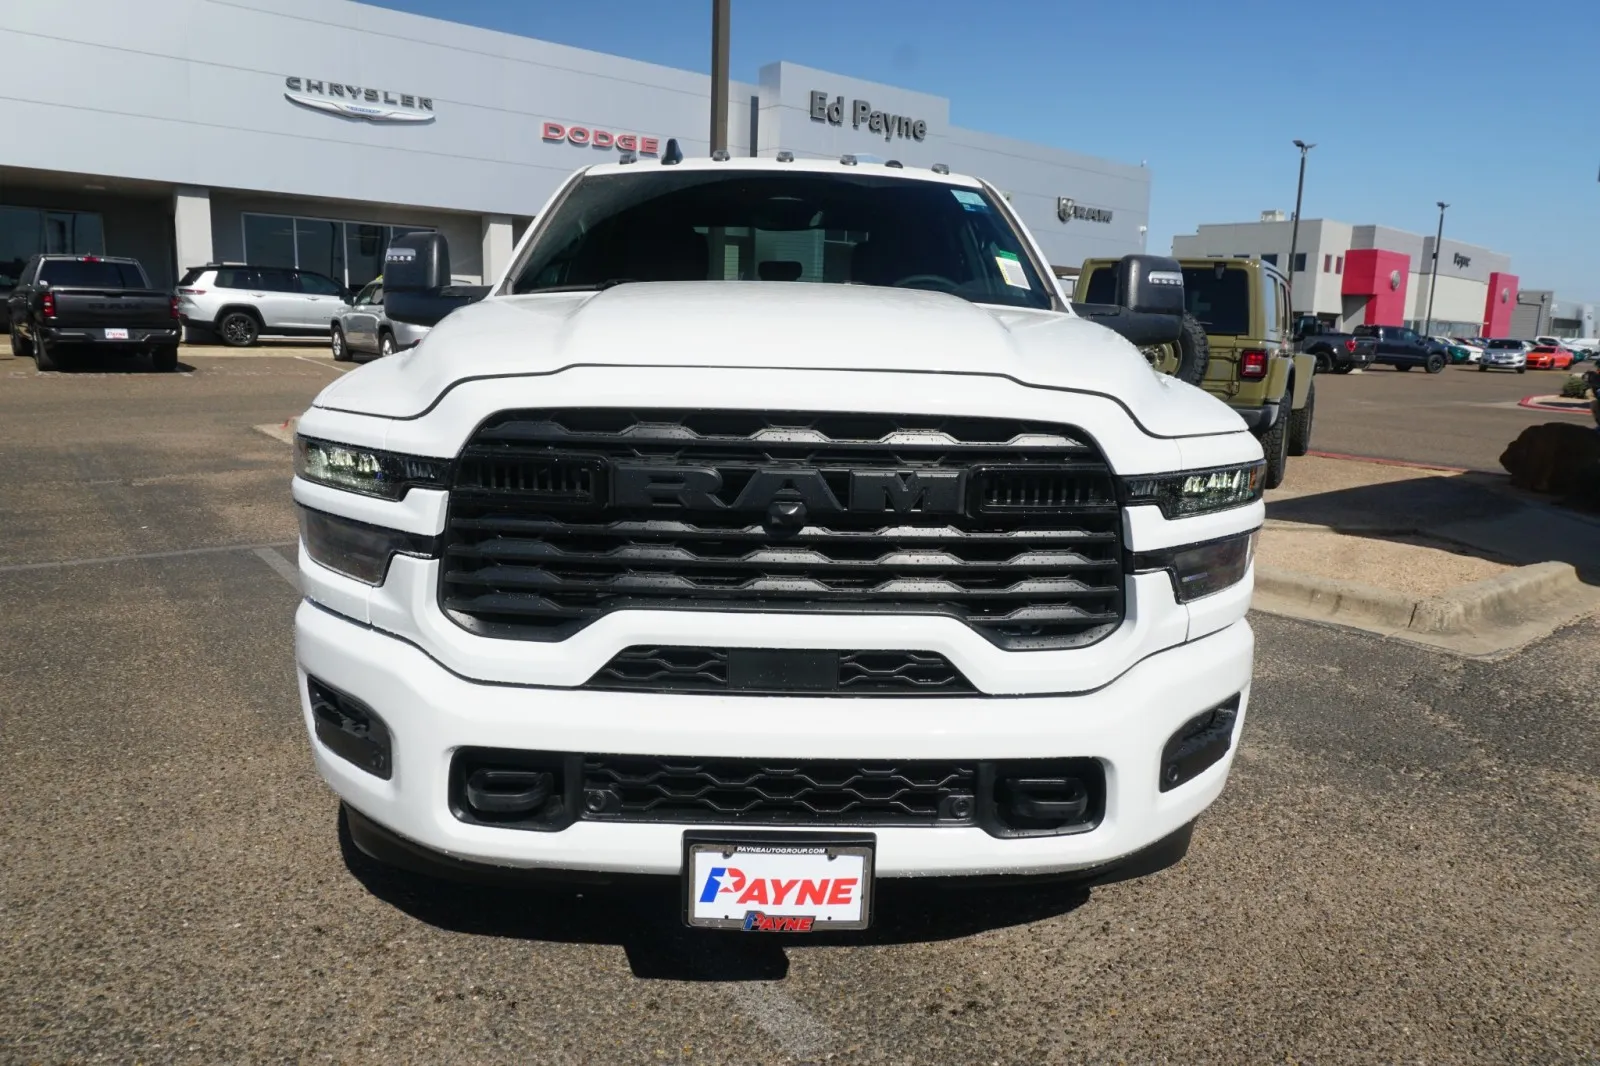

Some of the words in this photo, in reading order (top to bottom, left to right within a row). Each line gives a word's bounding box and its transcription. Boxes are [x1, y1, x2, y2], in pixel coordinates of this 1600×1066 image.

[286, 76, 433, 111] CHRYSLER
[810, 90, 845, 127] Ed
[852, 98, 928, 142] Payne
[541, 121, 660, 155] DODGE
[1073, 205, 1113, 224] RAM
[612, 464, 964, 513] RAM
[736, 846, 825, 854] PAYNEAUTOGROUP.COM
[699, 867, 858, 905] PAYNE
[743, 911, 813, 931] PAYNE
